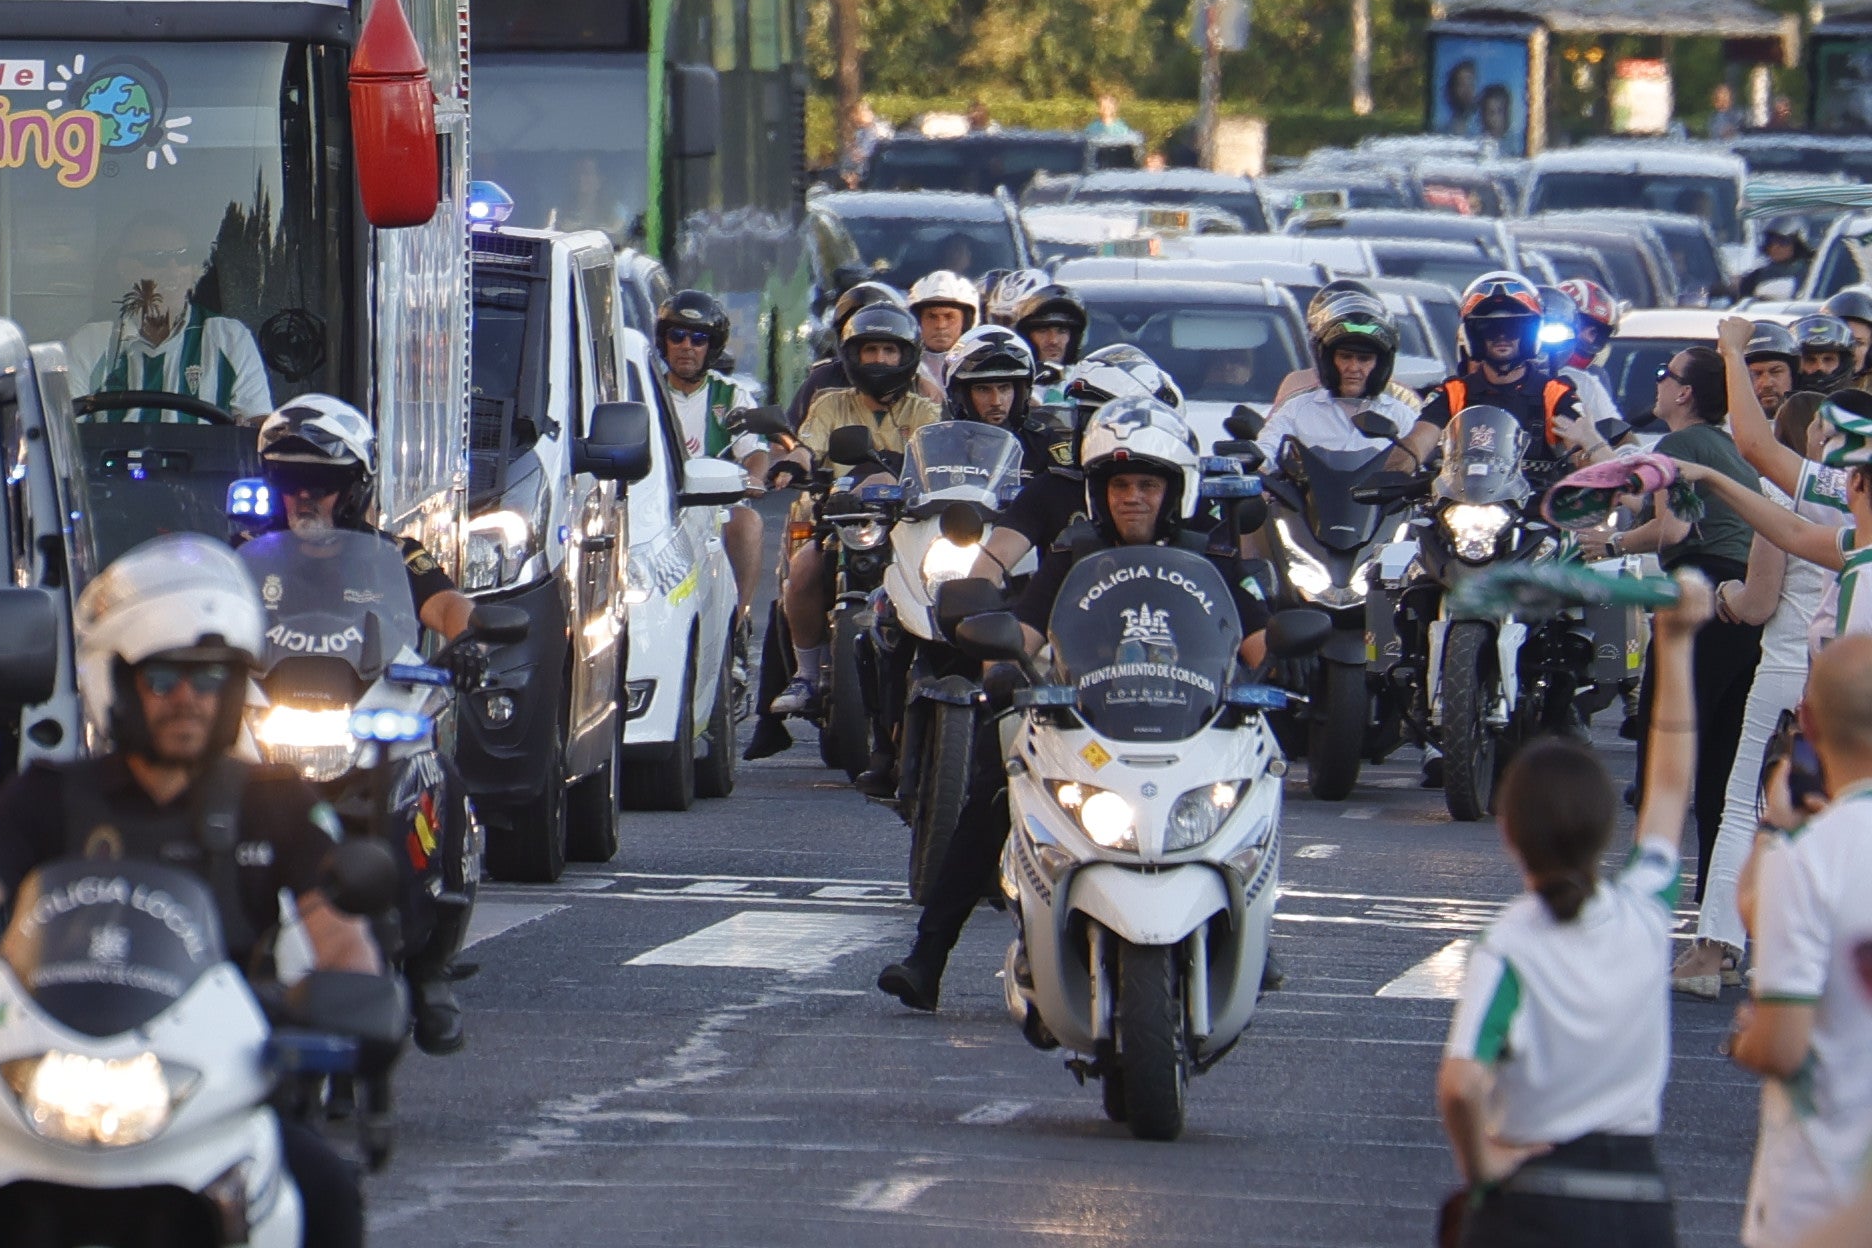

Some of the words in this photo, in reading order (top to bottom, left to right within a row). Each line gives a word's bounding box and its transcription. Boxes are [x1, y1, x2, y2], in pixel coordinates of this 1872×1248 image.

[925, 465, 990, 477] POLICIA
[1079, 565, 1151, 611] POLICIA
[1156, 566, 1214, 616] LOCAL
[1079, 663, 1156, 690] AYUNTAMIENTO
[1157, 663, 1170, 678] DE
